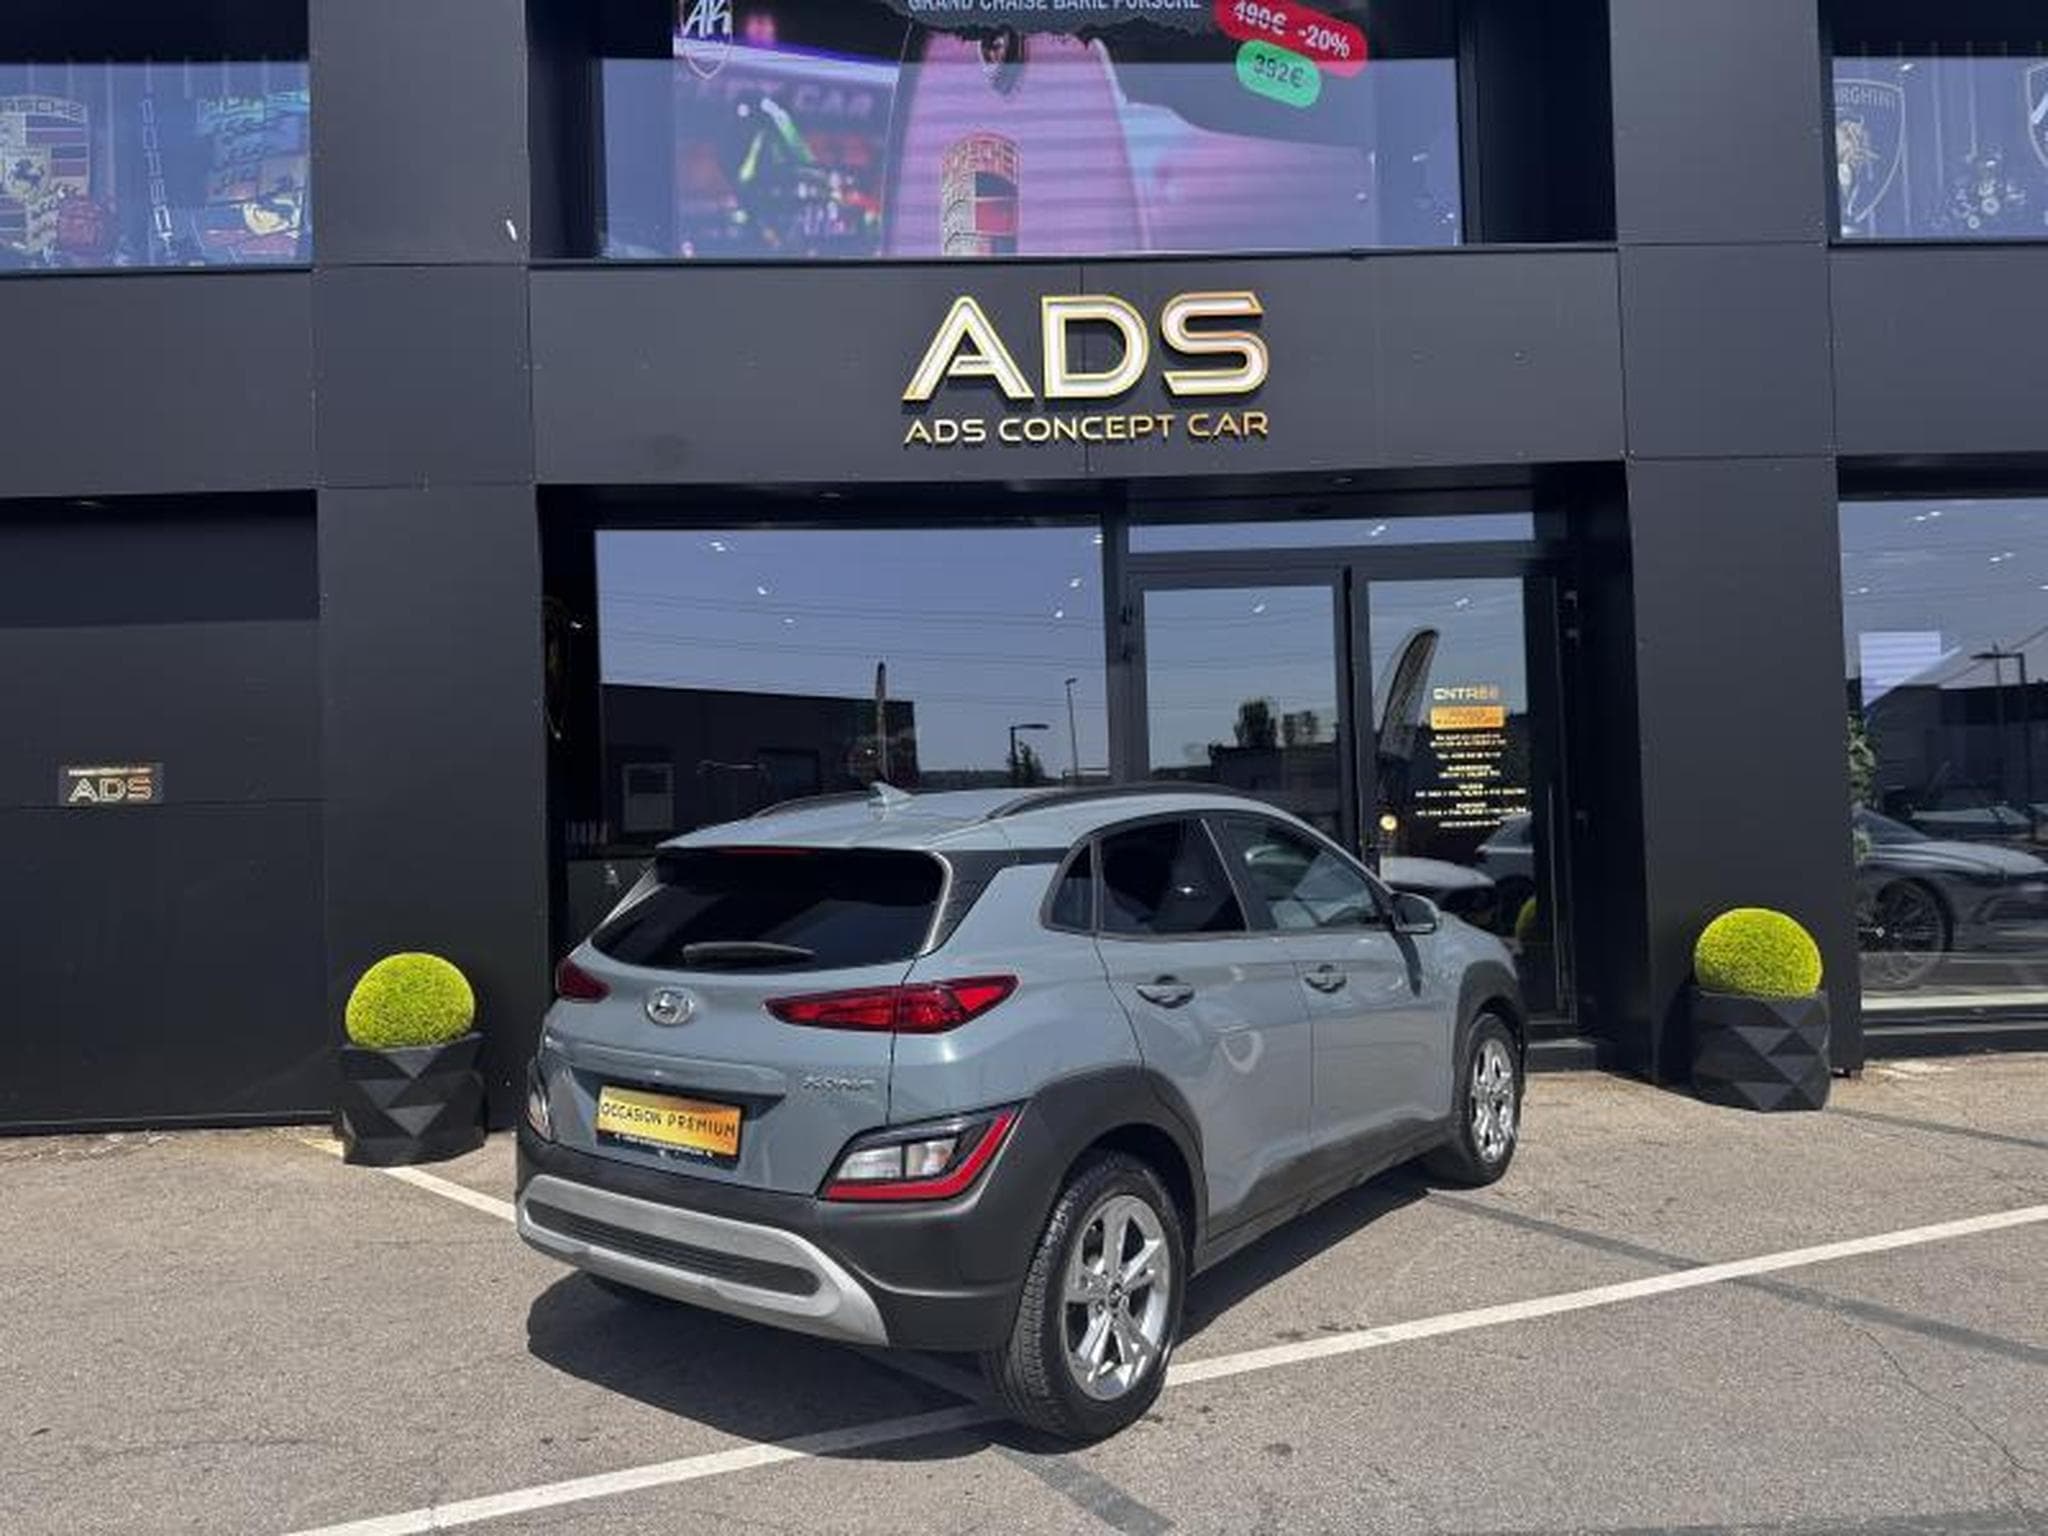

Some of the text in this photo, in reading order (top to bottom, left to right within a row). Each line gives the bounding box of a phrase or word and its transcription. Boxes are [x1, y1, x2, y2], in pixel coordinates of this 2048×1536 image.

[1298, 25, 1350, 58] -20%
[1253, 53, 1304, 88] 392€
[902, 291, 1269, 400] ADS
[904, 411, 1269, 444] ADS CONCEPT CAR
[68, 778, 152, 802] ADS
[667, 1113, 736, 1138] PREMIUM
